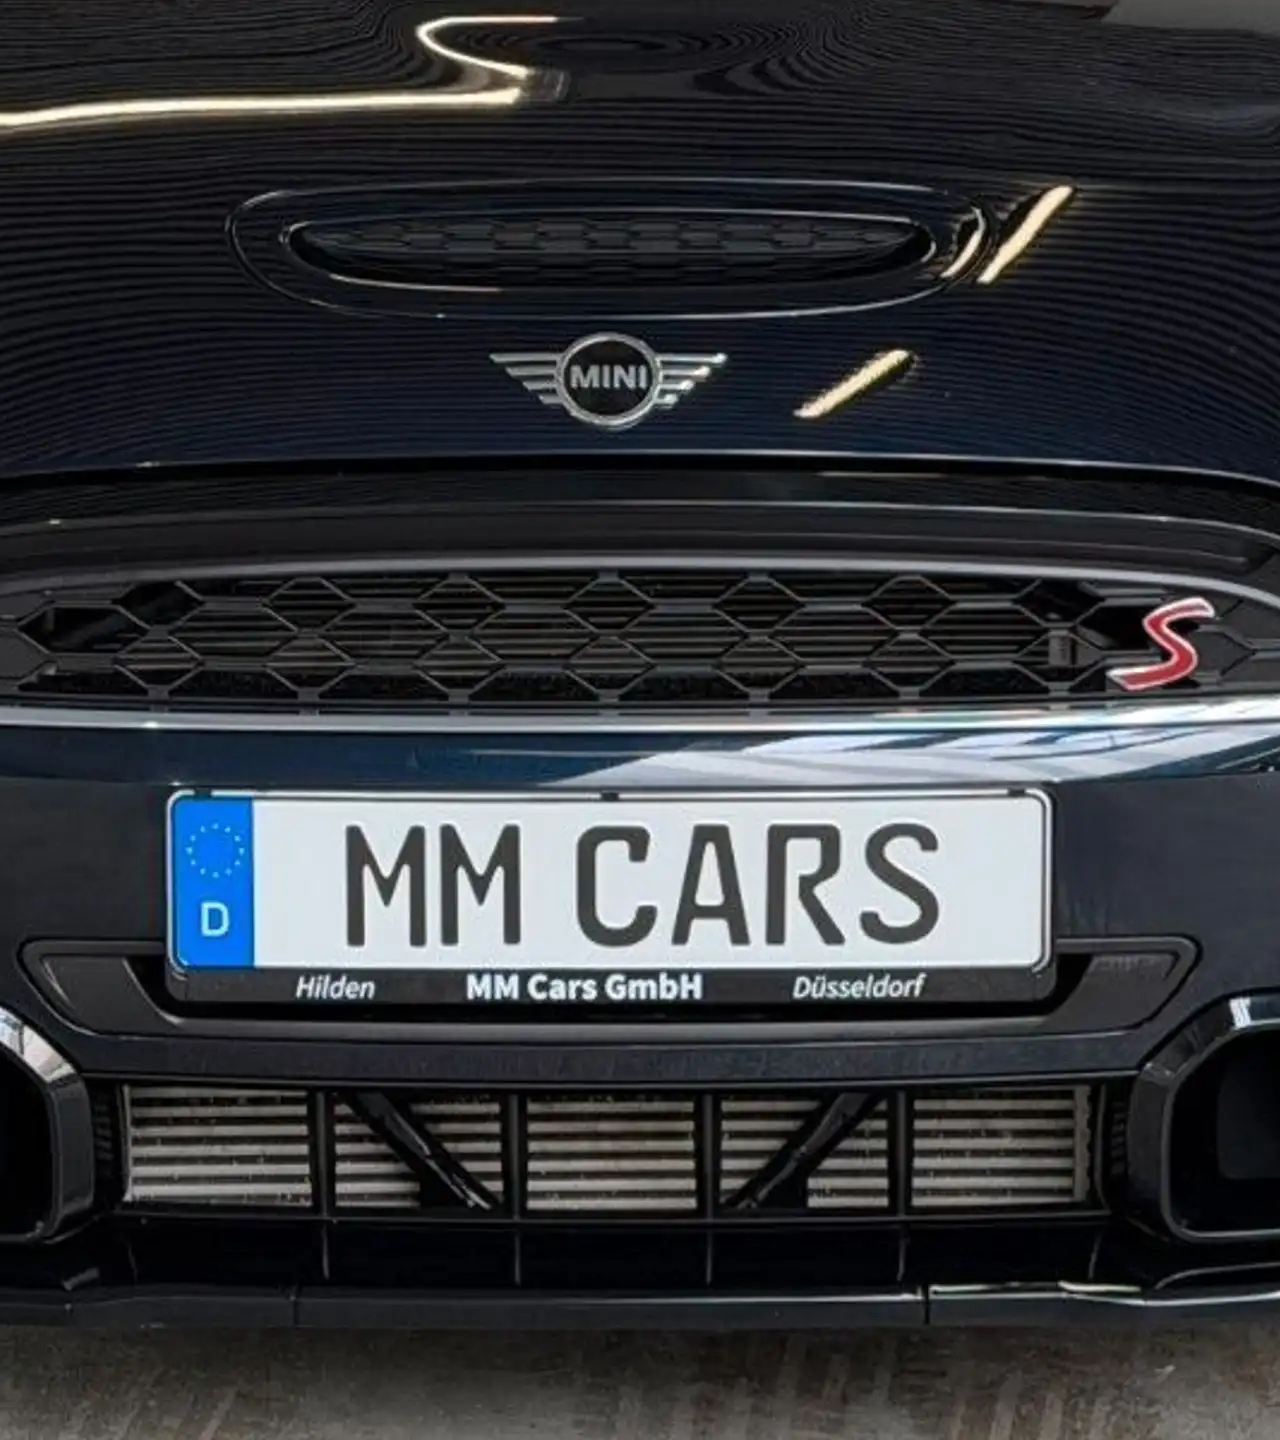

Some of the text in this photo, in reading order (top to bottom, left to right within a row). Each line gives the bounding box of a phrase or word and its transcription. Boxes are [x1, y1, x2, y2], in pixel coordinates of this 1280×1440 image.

[571, 364, 647, 389] MINI
[1105, 596, 1215, 691] S
[346, 822, 940, 947] MM CARS
[200, 902, 229, 936] D
[296, 972, 926, 1001] Hilden MM Cars GmbH Düsseldorf
